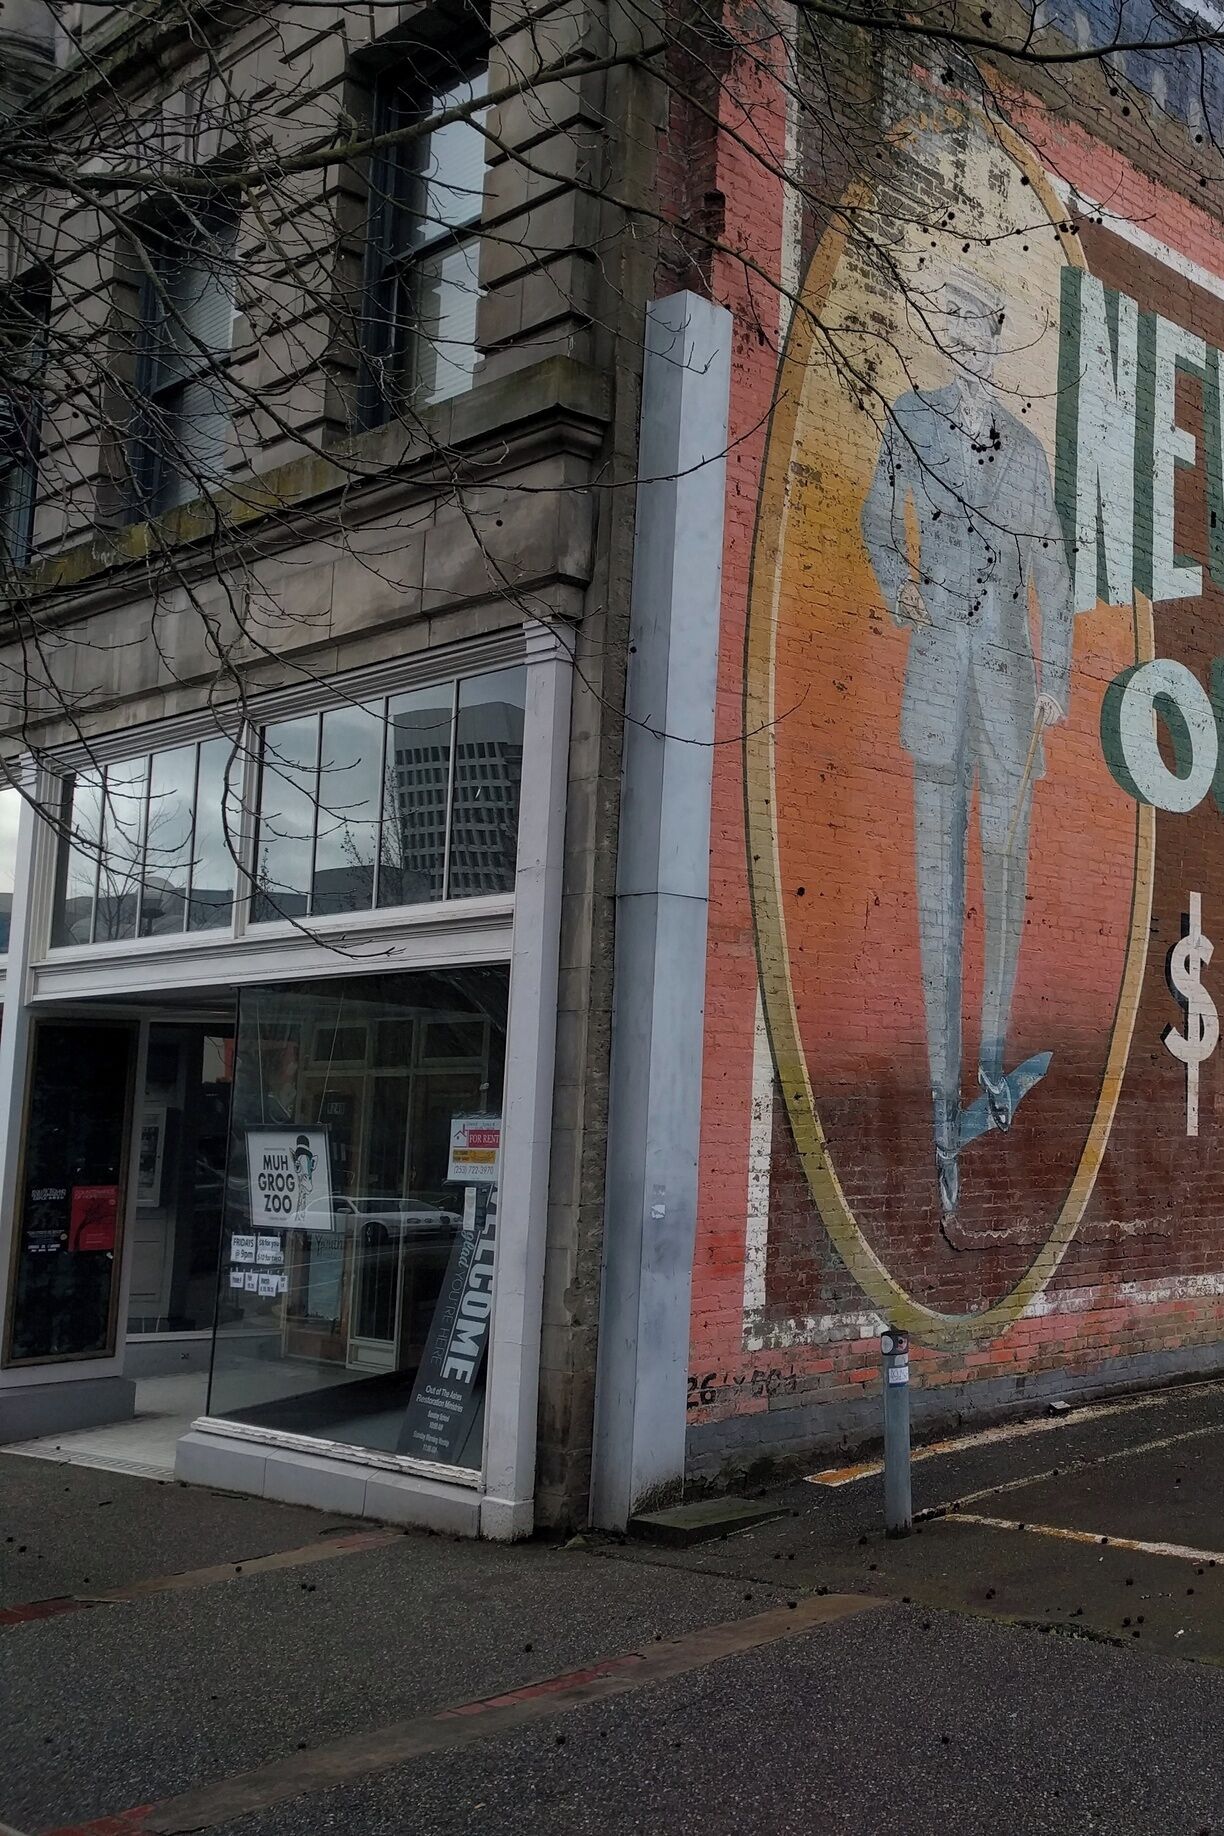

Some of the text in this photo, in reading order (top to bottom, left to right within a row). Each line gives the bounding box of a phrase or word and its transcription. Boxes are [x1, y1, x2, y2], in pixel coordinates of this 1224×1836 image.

[469, 1134, 500, 1144] FOR RENT
[263, 1154, 288, 1171] MUH
[258, 1172, 295, 1192] GROG
[264, 1194, 292, 1214] ZOO
[233, 1237, 255, 1248] FRIDAYS
[240, 1249, 253, 1260] 9pm
[442, 1190, 498, 1384] LCOME
[425, 1385, 436, 1395] Out
